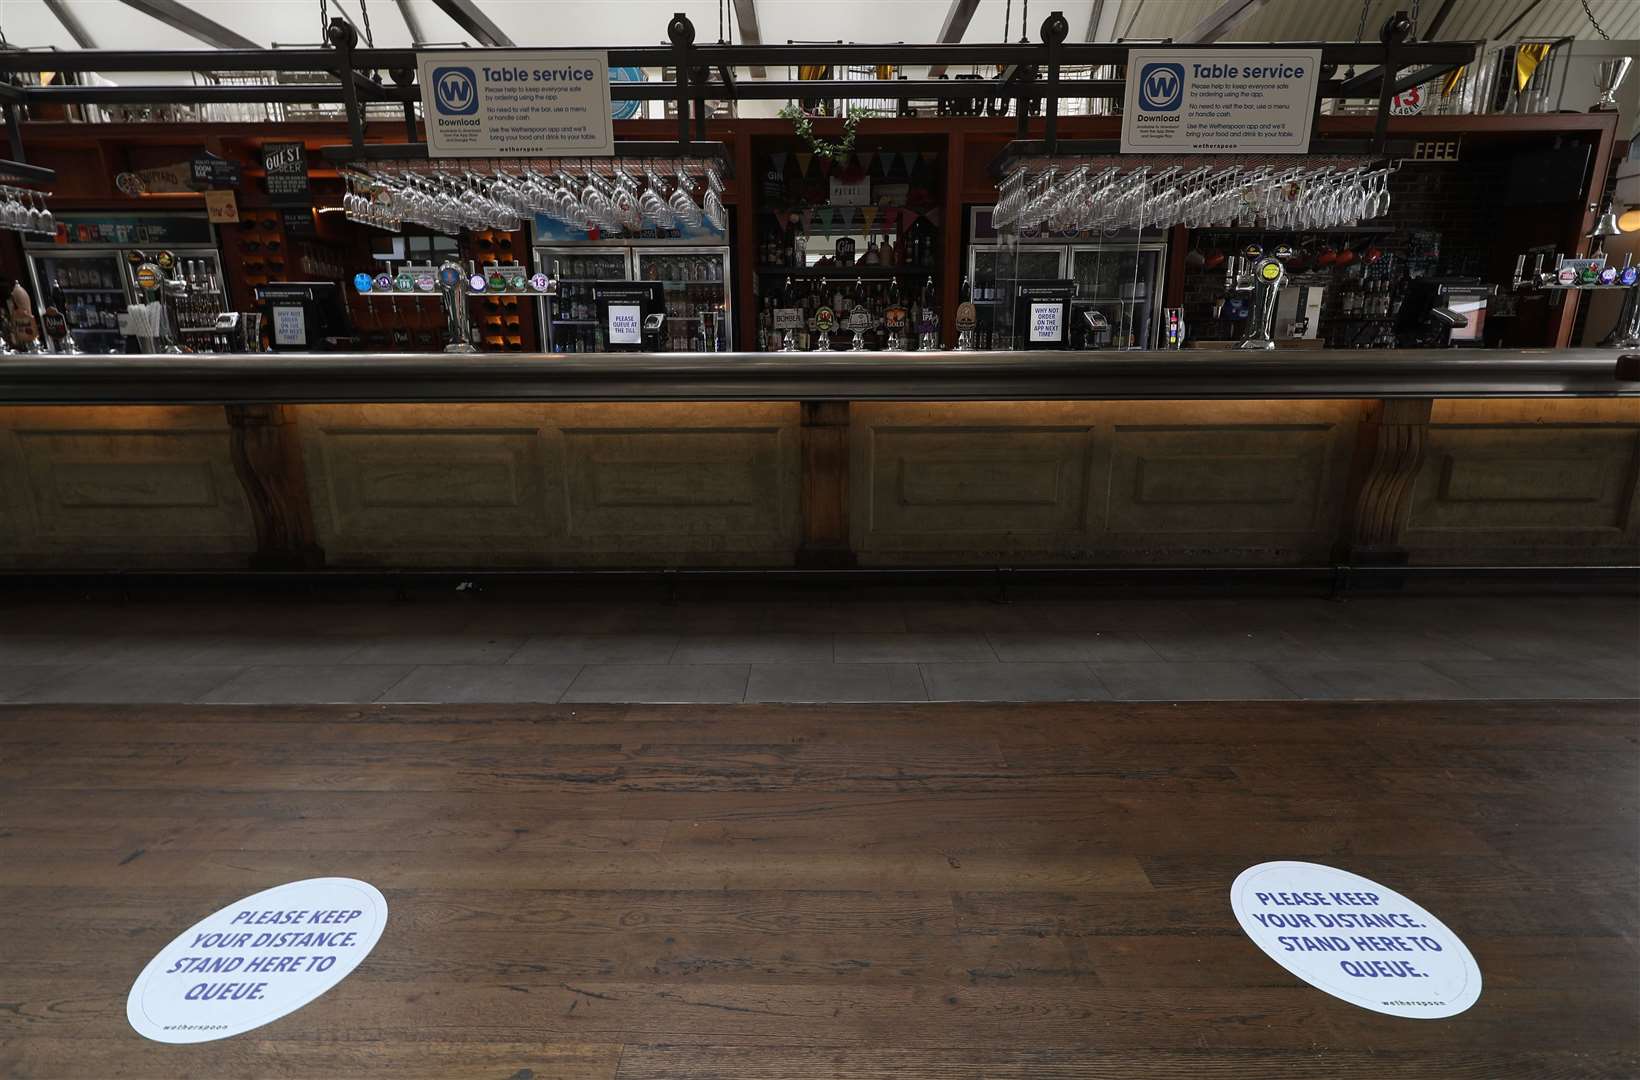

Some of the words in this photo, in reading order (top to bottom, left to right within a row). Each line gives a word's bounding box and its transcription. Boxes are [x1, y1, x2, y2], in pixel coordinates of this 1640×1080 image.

[483, 67, 528, 81] Table
[533, 66, 593, 81] service
[1193, 64, 1238, 78] Table
[1243, 63, 1304, 78] service
[441, 81, 467, 101] W
[1150, 78, 1177, 97] W
[438, 118, 480, 126] Download
[1138, 114, 1180, 122] Download
[265, 146, 301, 170] GUEST
[1256, 892, 1330, 906] PLEASE
[1329, 892, 1380, 906] KEEP
[230, 910, 308, 924] PLEASE
[308, 910, 362, 924] KEEP
[1252, 914, 1318, 928] YOUR
[1317, 914, 1426, 928] DISTANCE.
[190, 933, 252, 948] YOUR
[250, 932, 358, 947] DISTANCE.
[1278, 936, 1351, 952] STAND
[1350, 936, 1413, 952] HERE
[1407, 936, 1443, 952] TO
[166, 957, 244, 974] STAND
[242, 956, 308, 972] HERE
[305, 956, 336, 972] TO
[1340, 960, 1429, 978] QUEUE.
[184, 982, 268, 1000] QUEUE.
